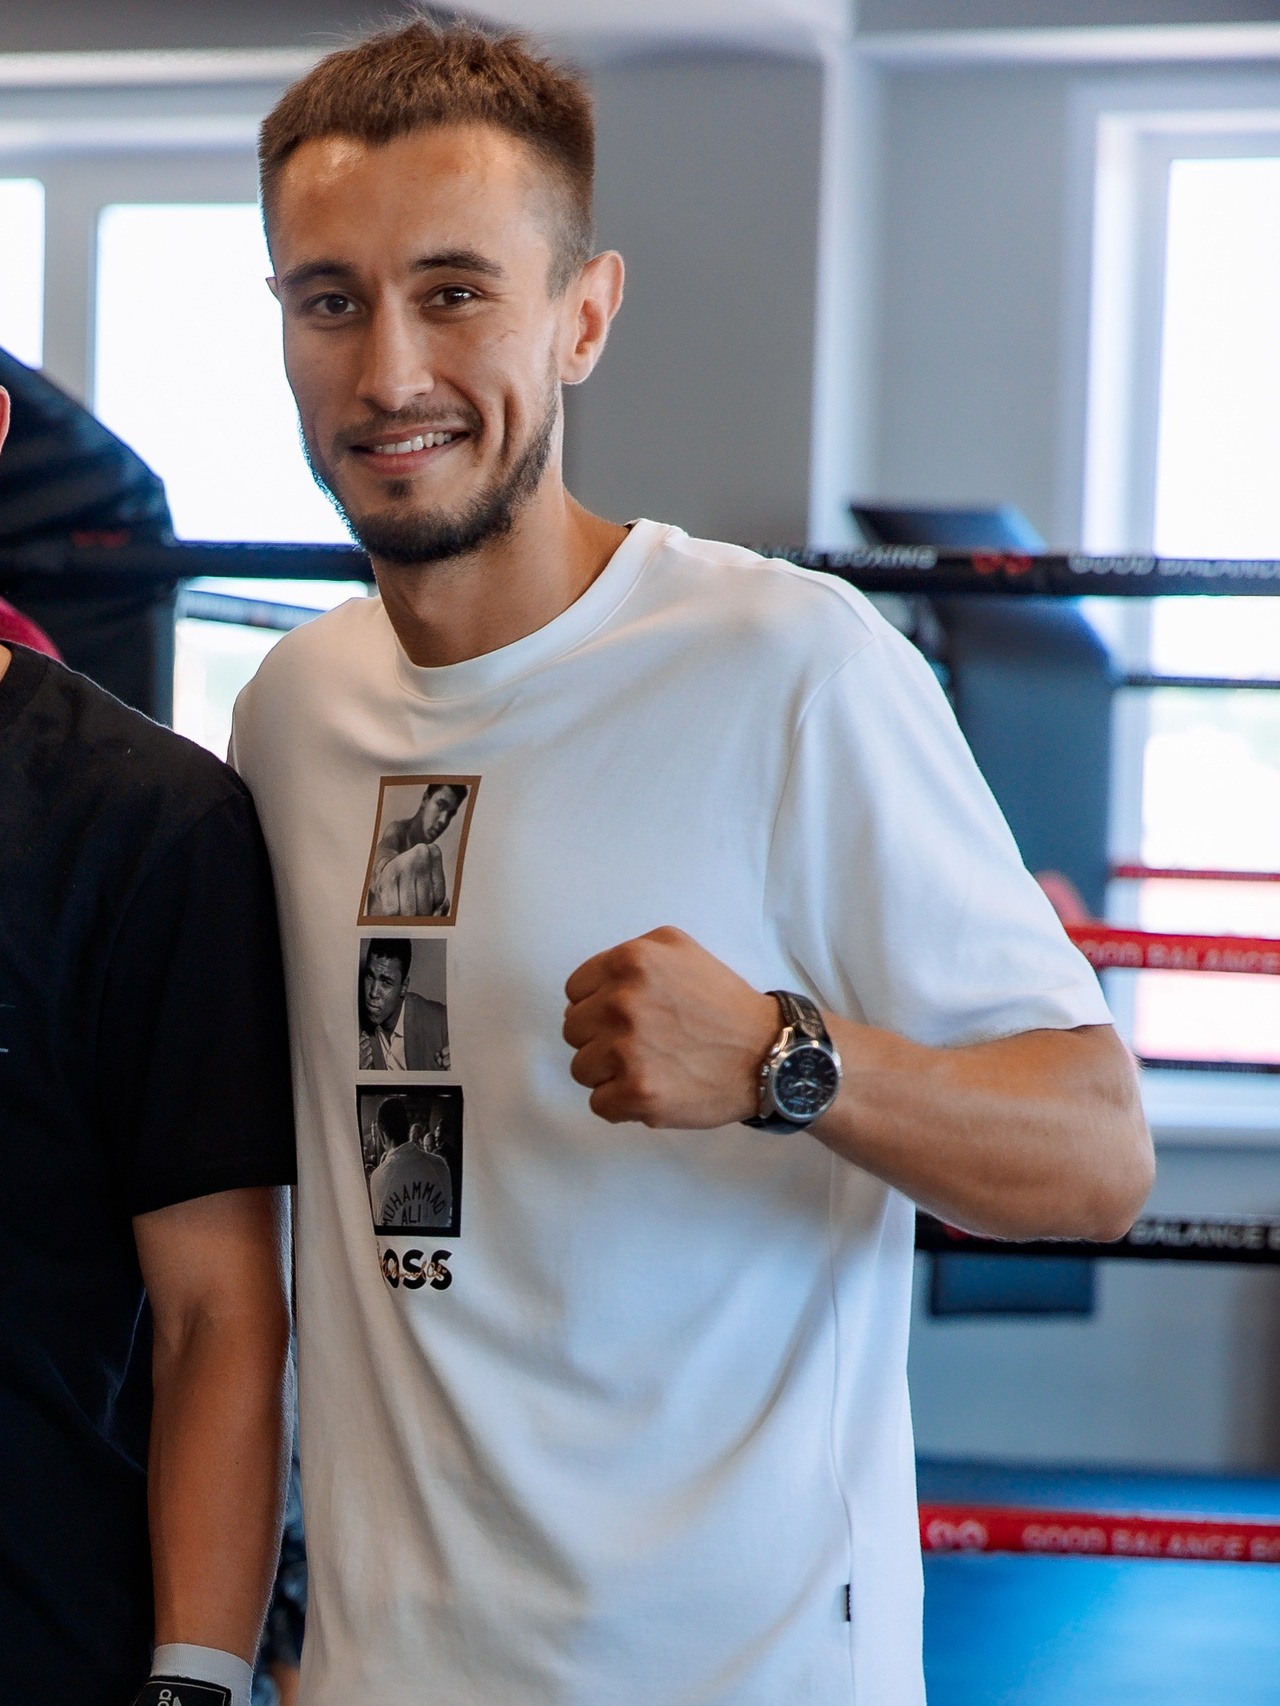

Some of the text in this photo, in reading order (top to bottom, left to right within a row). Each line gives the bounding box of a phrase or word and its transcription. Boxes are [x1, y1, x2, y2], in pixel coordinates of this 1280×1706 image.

[1158, 560, 1280, 580] BALANC
[1077, 939, 1144, 968] OOD
[383, 1181, 445, 1226] MUHAMMAD
[402, 1203, 421, 1226] ALI
[382, 1248, 453, 1291] OSS
[1021, 1523, 1108, 1554] GOOD
